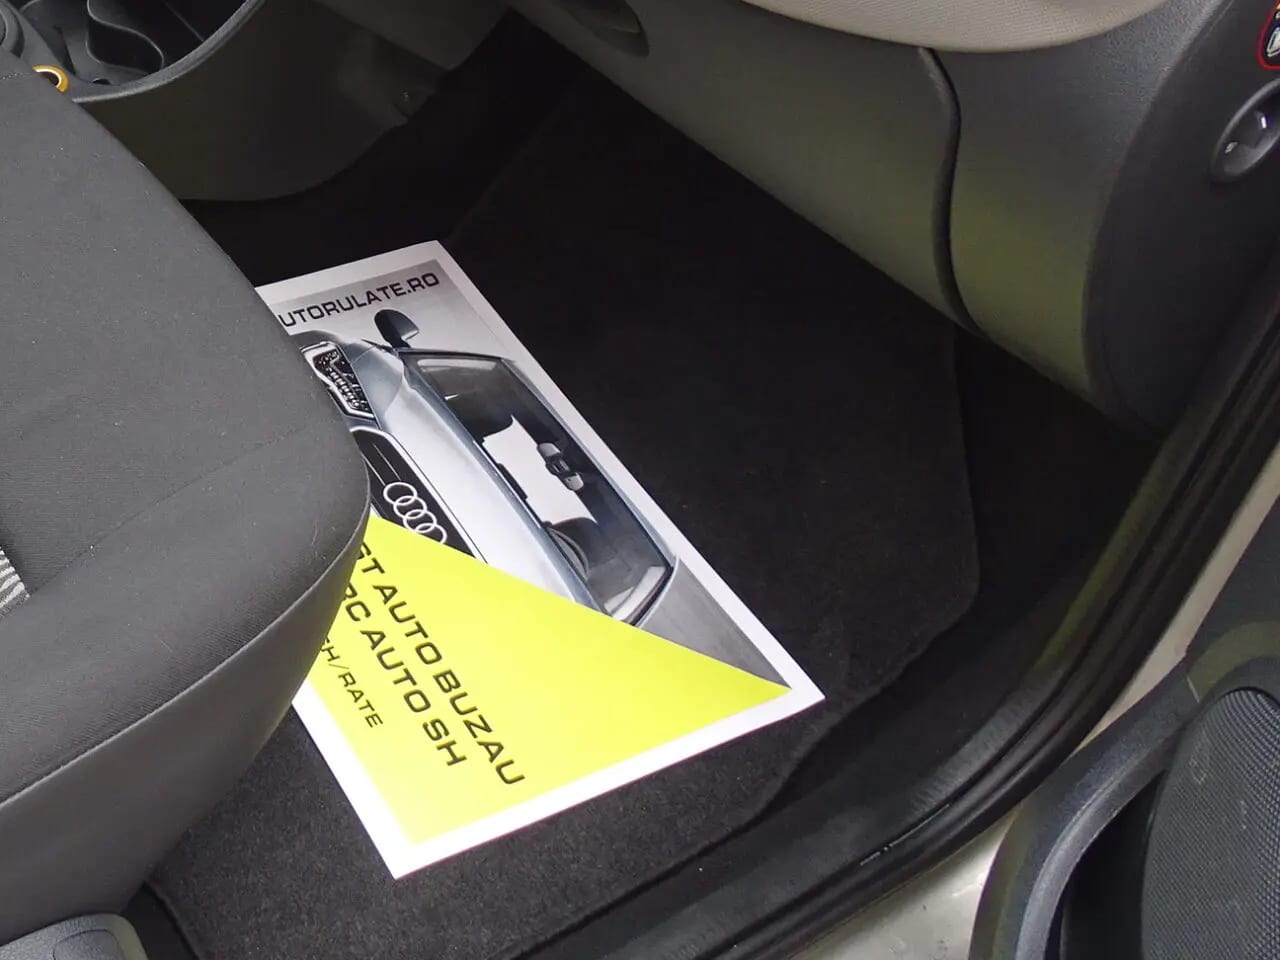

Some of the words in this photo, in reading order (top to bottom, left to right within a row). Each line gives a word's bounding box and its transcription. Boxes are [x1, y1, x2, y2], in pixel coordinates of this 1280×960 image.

[278, 272, 439, 327] UTORULATE.RO
[360, 630, 431, 712] AUTO
[423, 718, 467, 766] SH
[372, 585, 442, 665] AUTO
[433, 669, 525, 784] BUZAU
